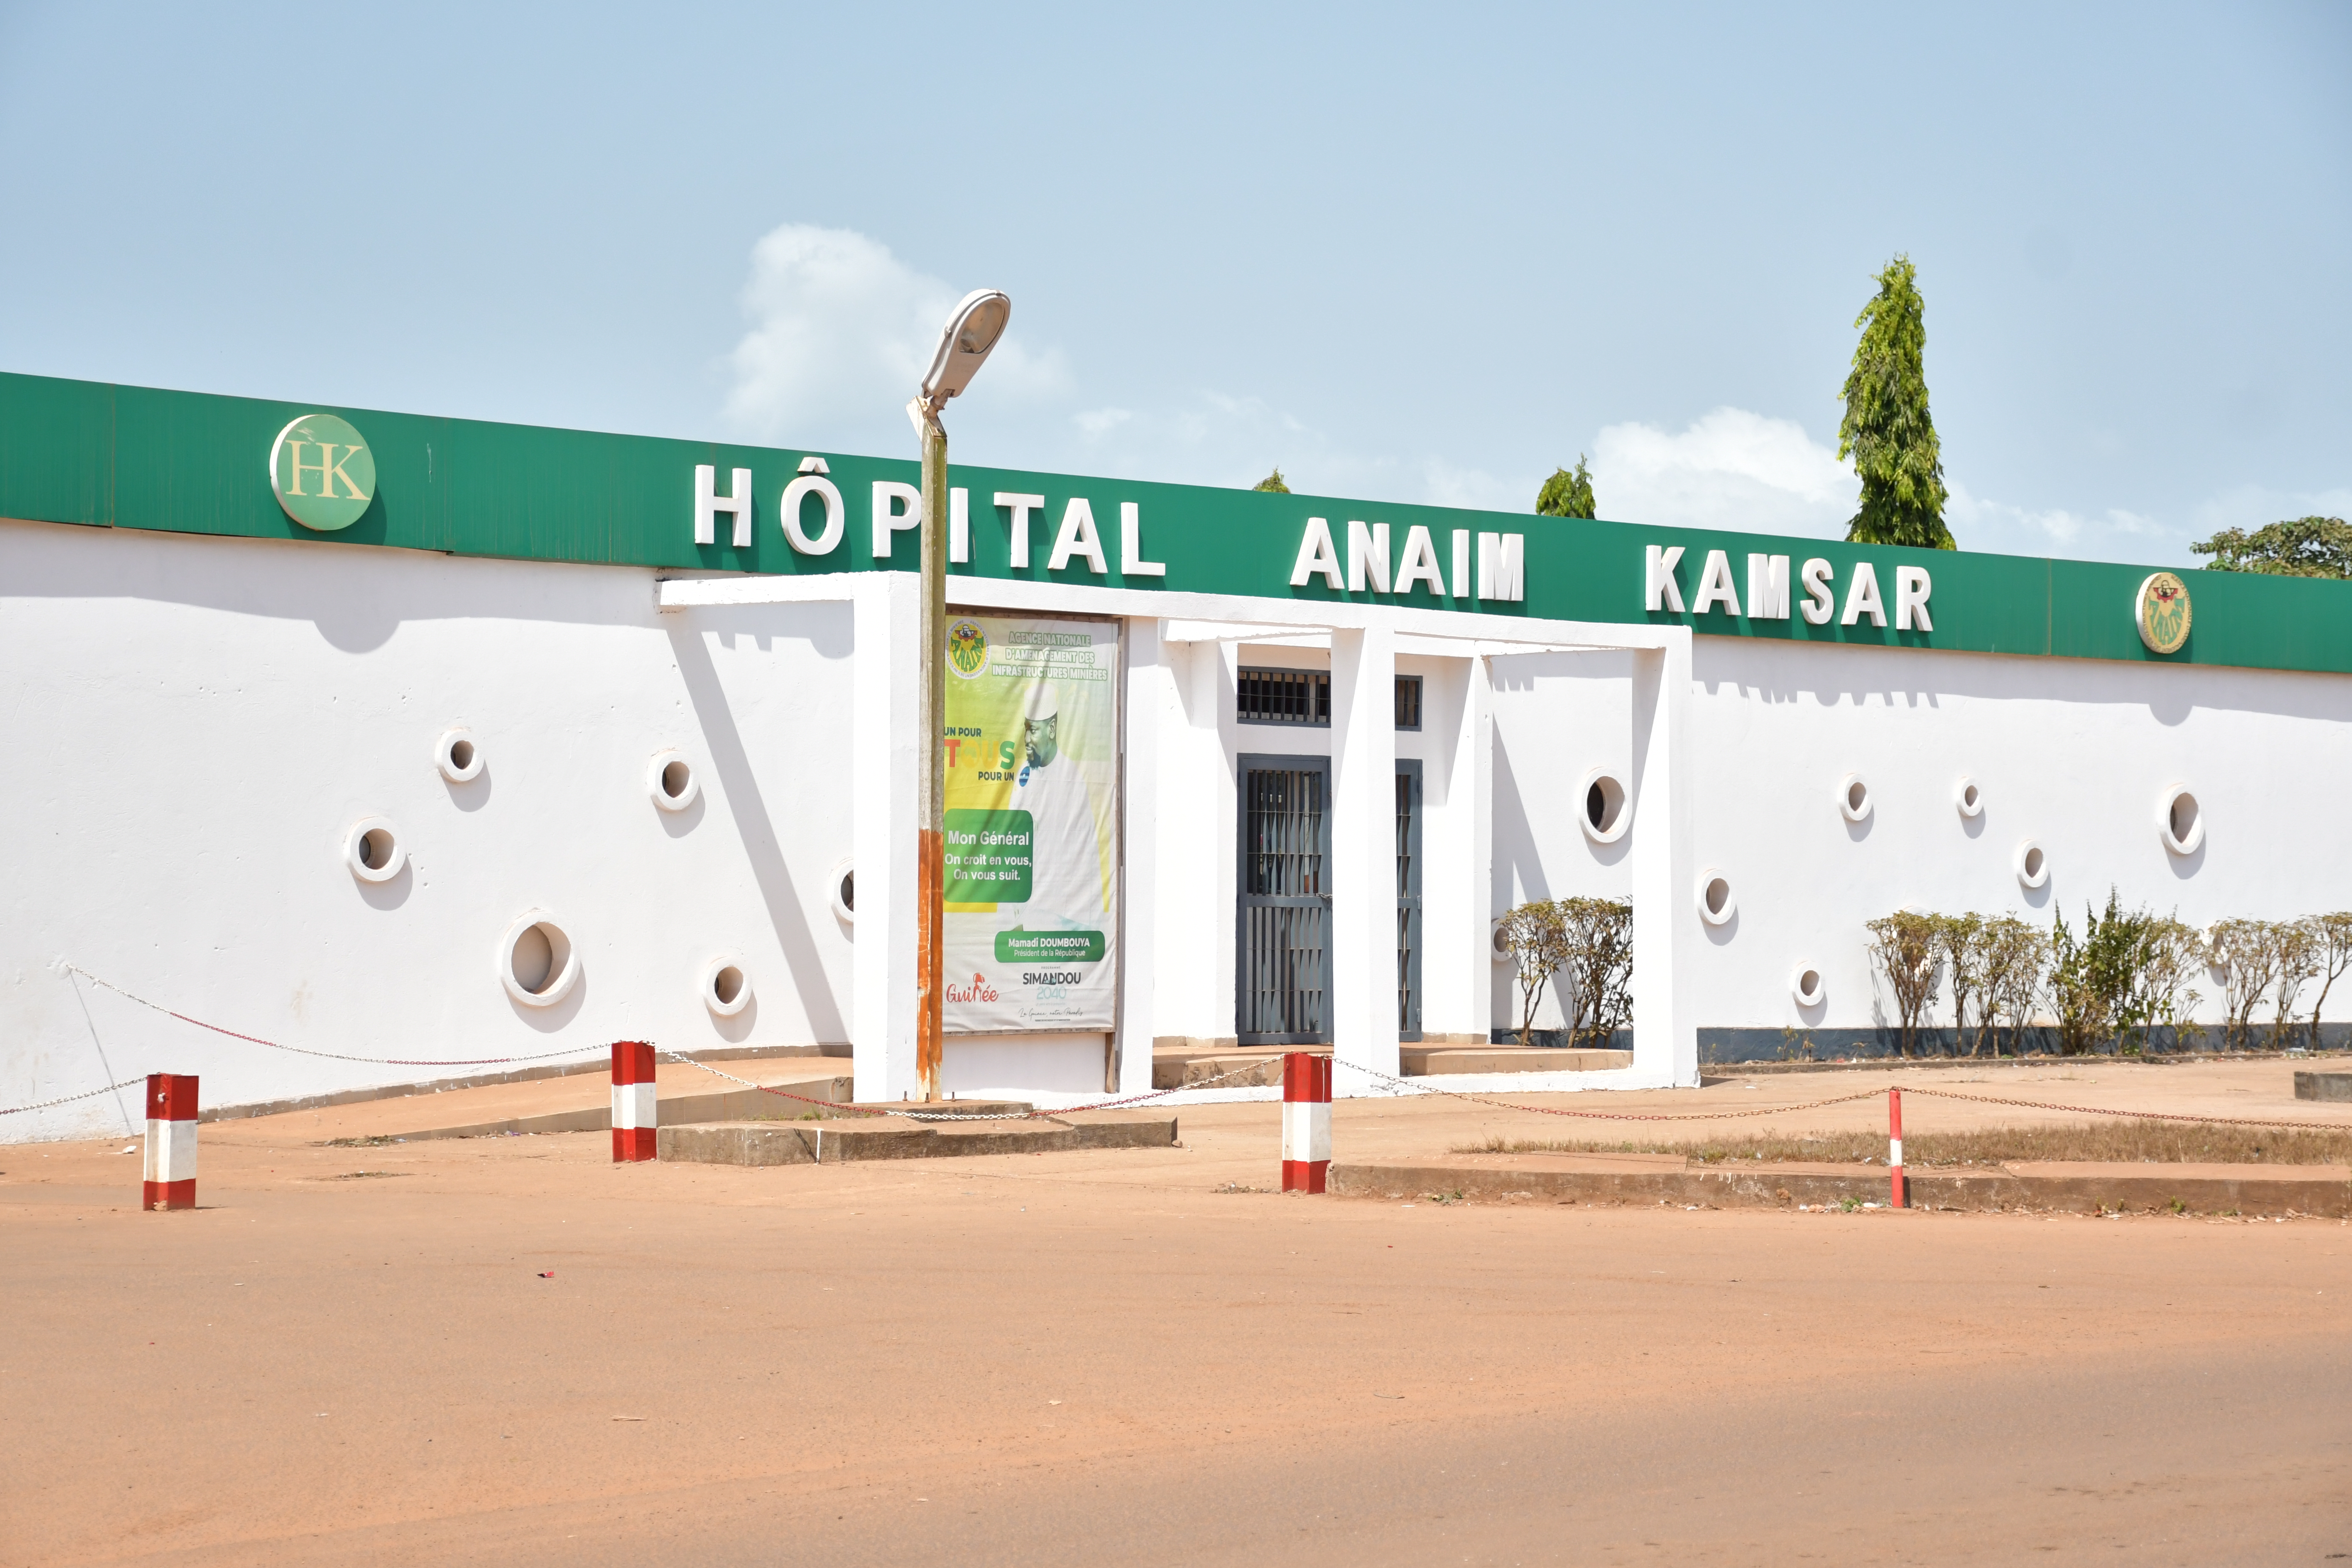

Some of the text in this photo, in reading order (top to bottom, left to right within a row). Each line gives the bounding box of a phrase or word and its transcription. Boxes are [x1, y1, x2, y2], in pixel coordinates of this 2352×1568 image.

[286, 440, 370, 501] HK
[695, 457, 1933, 632] HÔPITAL ANAIM KAMSAR
[1009, 632, 1091, 647] AGENCE NATIONALE
[951, 636, 984, 672] ANAIM
[1005, 648, 1095, 664] D'AMENAGEMENT DES
[992, 664, 1108, 681] INFRASTRUCTURES MINIÈRES
[944, 727, 982, 737] UN POUR
[944, 739, 1015, 770] TOUS
[978, 771, 1014, 781] POUR UN
[948, 830, 1029, 845] Mon Général
[945, 853, 1032, 867] On croit en vous,
[954, 868, 1021, 880] On vous suit.
[1008, 937, 1090, 947] Mamadi DOUMBOUYA
[1055, 949, 1086, 958] République
[1023, 972, 1081, 985] SIMANDOU
[946, 973, 999, 1003] Guinée
[1037, 986, 1067, 999] 2040
